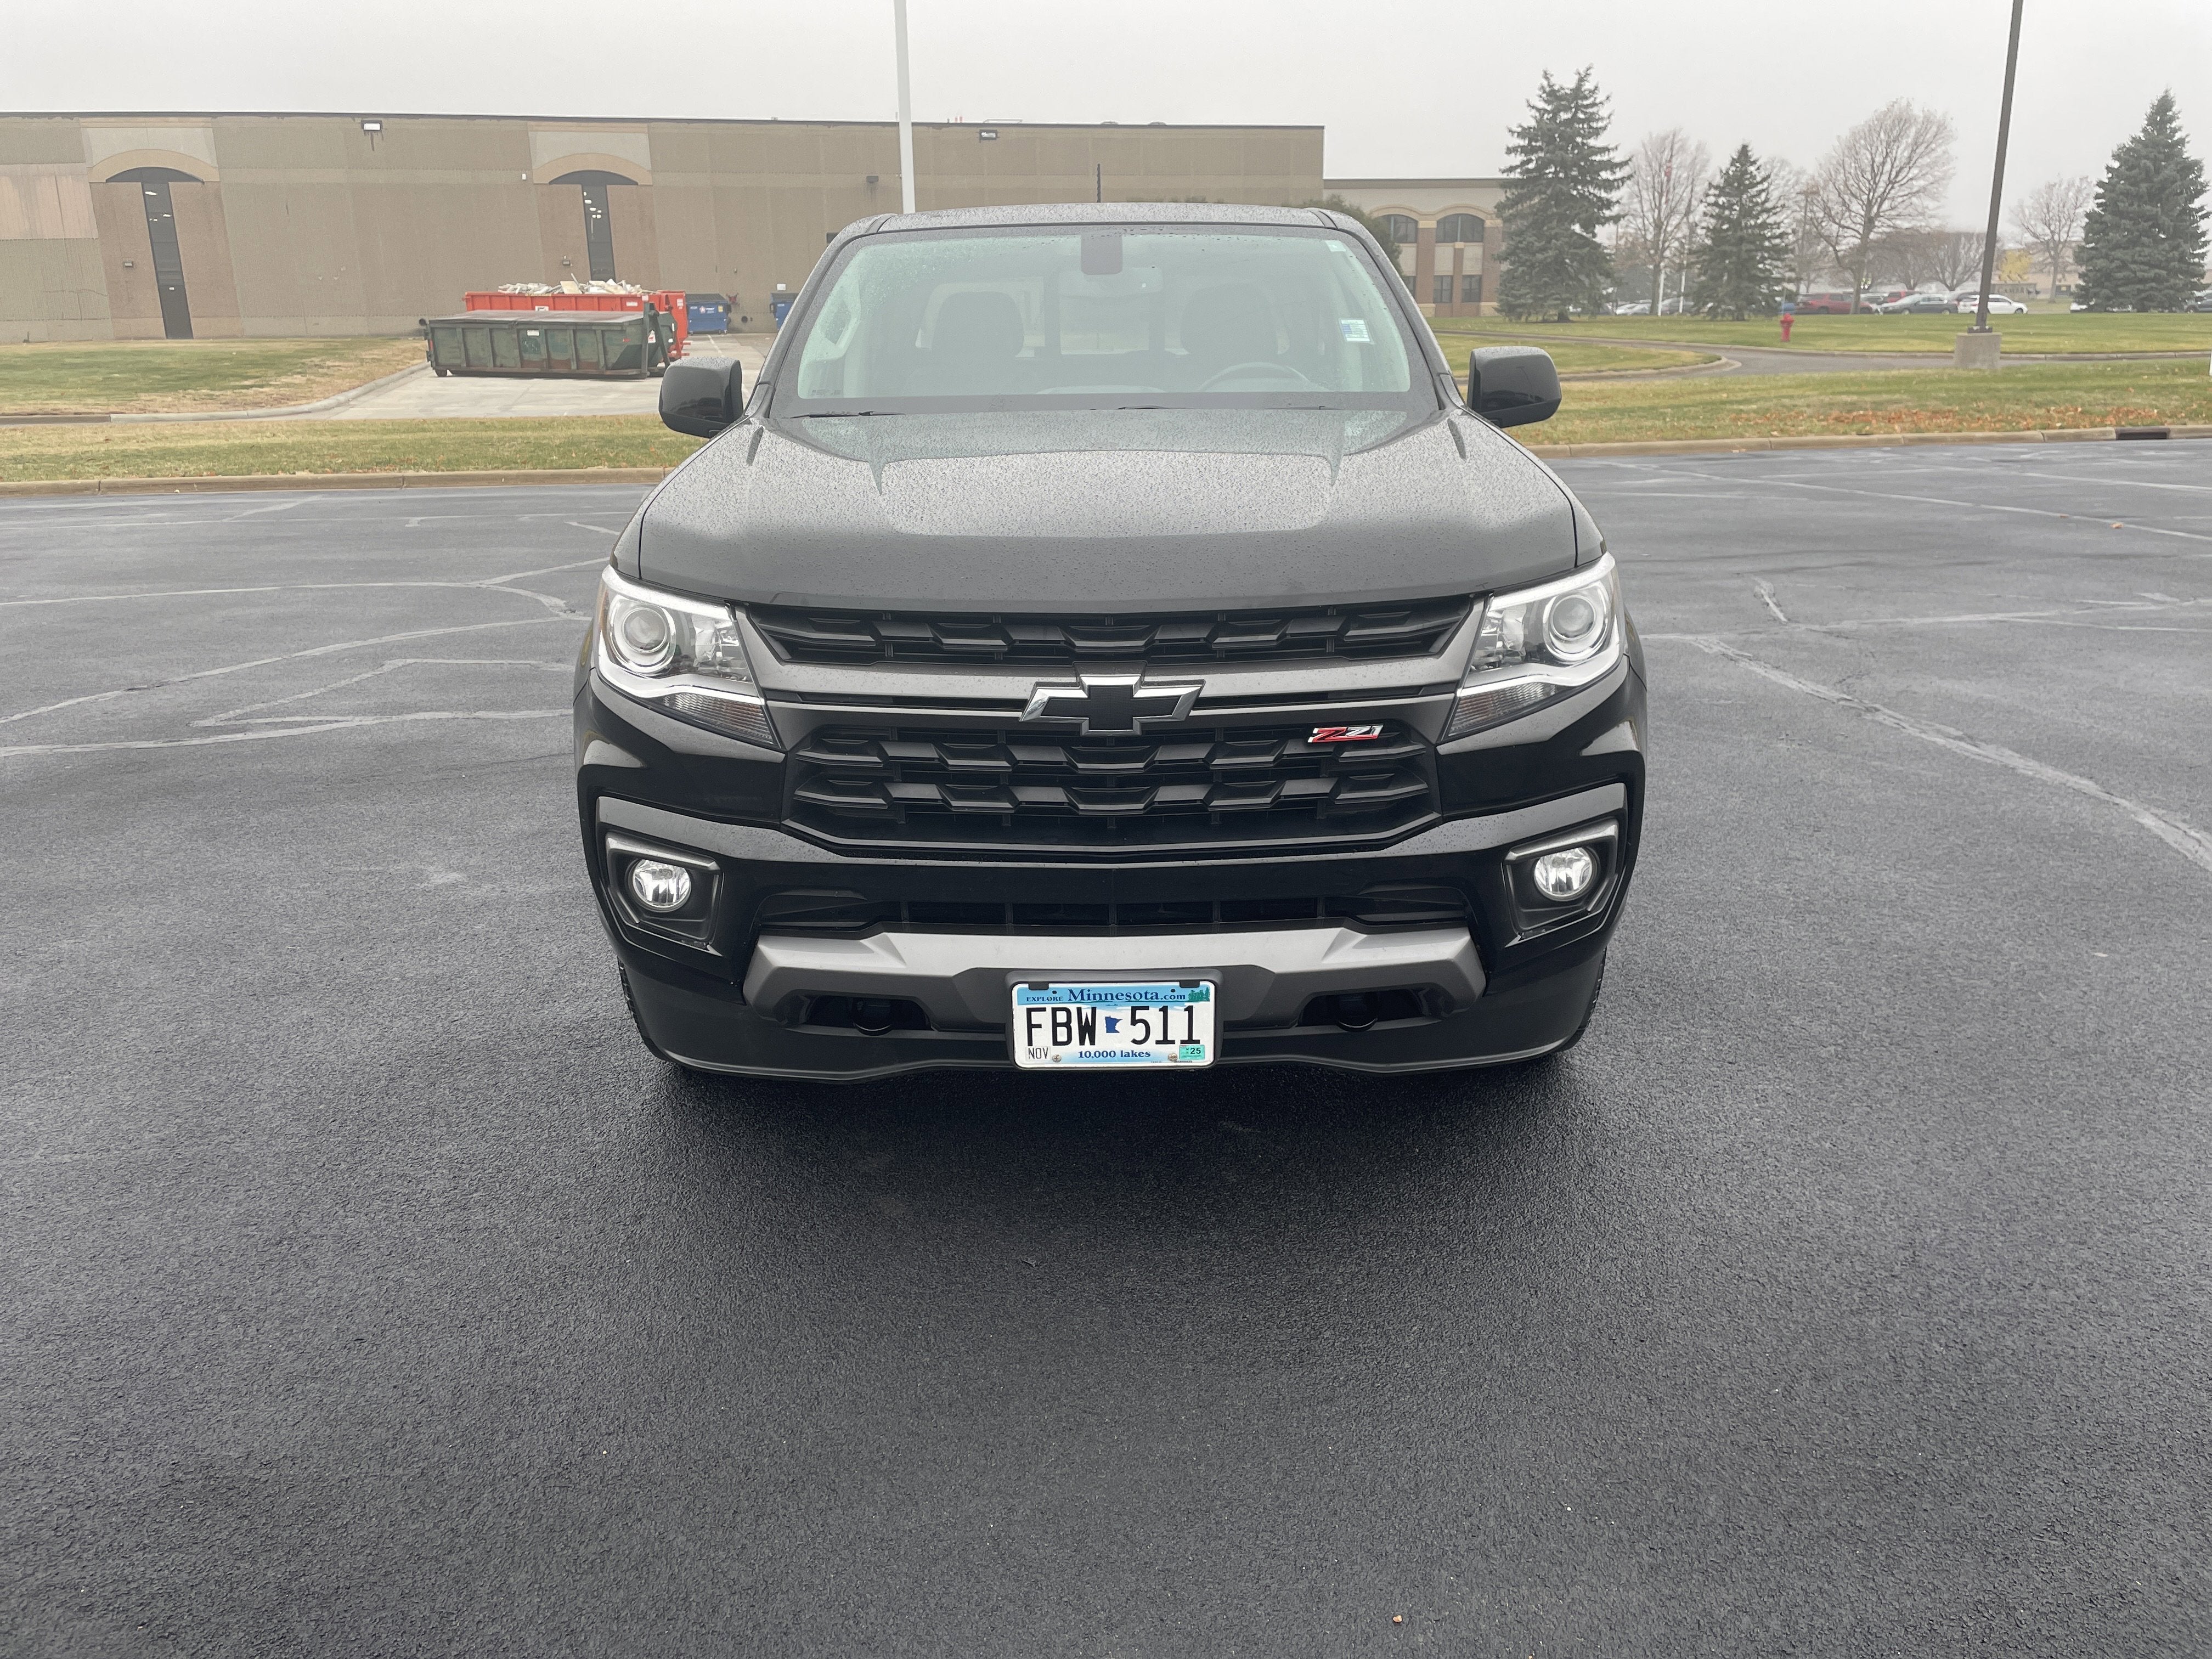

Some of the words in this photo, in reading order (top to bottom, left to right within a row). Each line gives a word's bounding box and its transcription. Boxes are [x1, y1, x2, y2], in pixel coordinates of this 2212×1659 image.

[1307, 725, 1384, 743] Z71
[1026, 1006, 1097, 1047] FBW
[1130, 1005, 1200, 1045] 511
[1028, 1047, 1048, 1059] NOV
